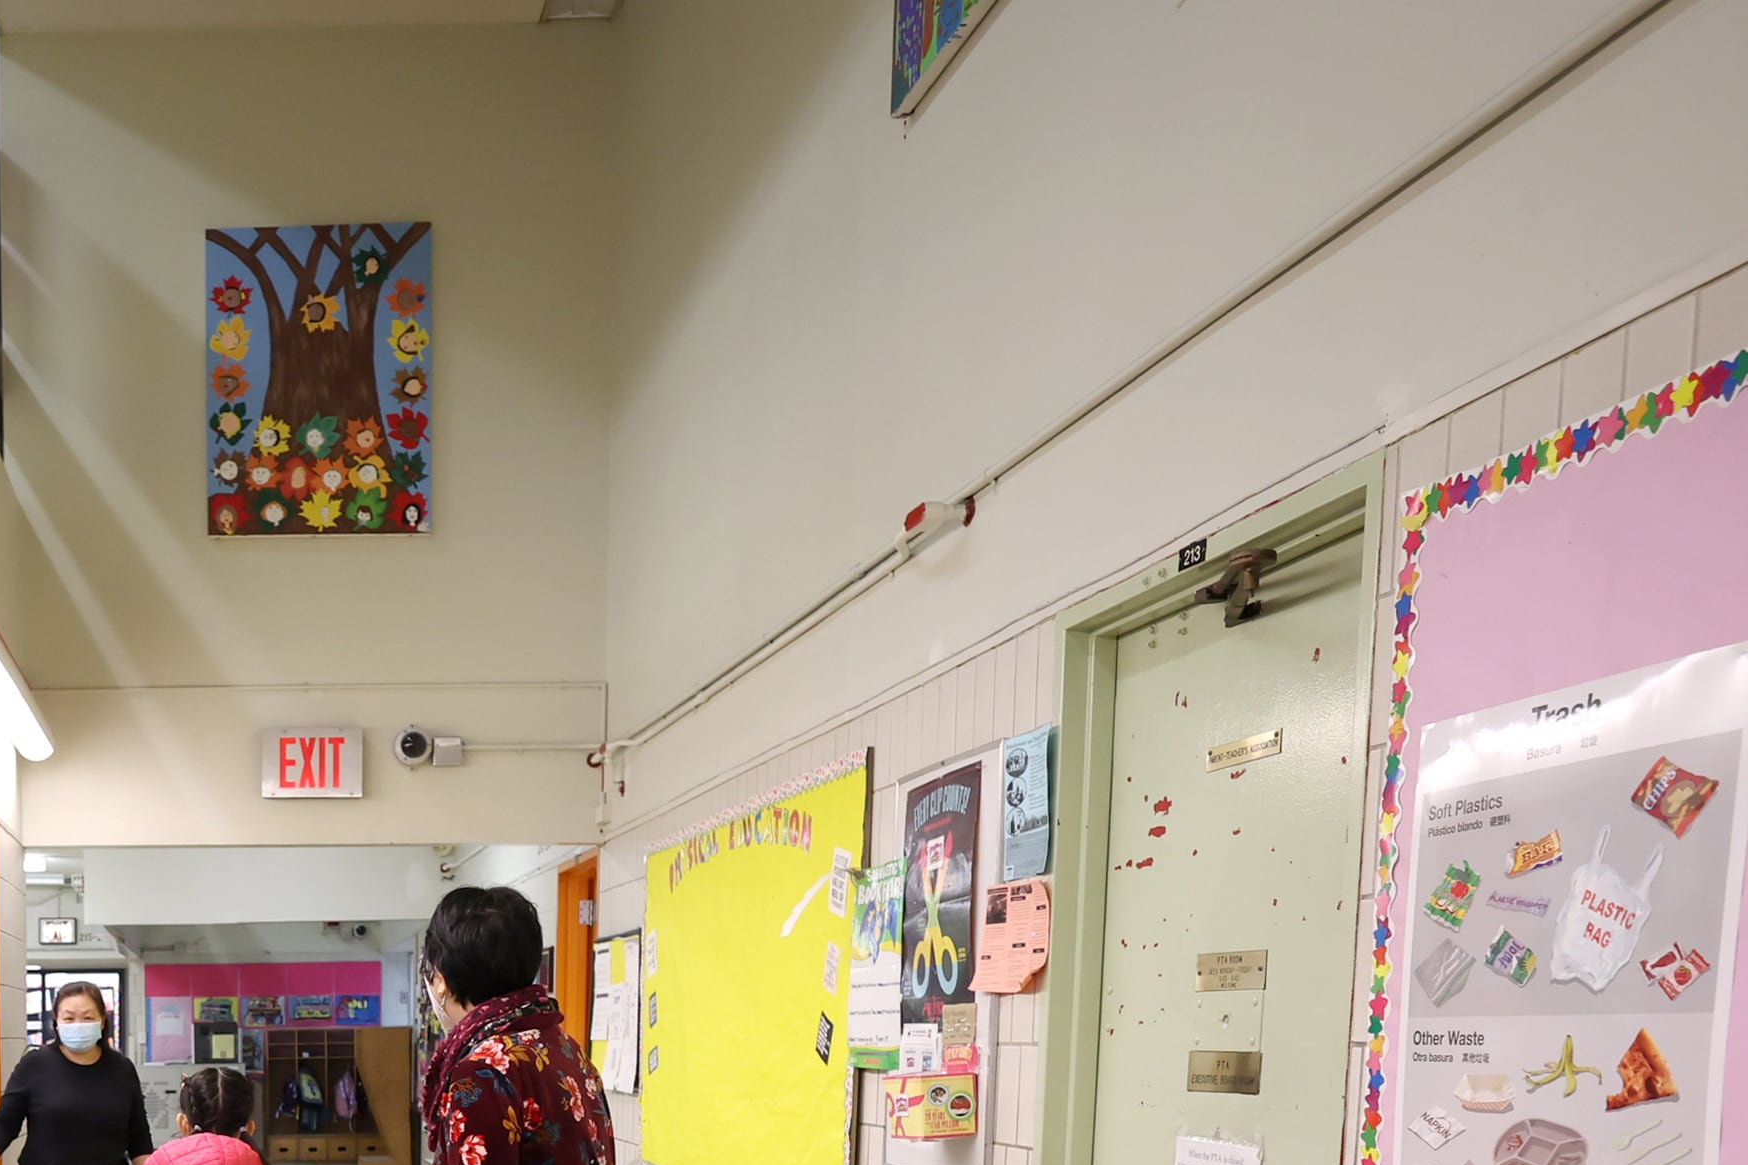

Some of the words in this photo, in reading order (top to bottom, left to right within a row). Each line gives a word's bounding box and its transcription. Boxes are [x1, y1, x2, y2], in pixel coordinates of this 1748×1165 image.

[1183, 545, 1201, 566] 213
[279, 737, 345, 788] EXIT
[1643, 768, 1677, 810] CHIPS
[1429, 803, 1452, 821] Soft
[1455, 795, 1503, 816] Plastics
[729, 808, 812, 854] EDUCATION
[1457, 819, 1483, 833] blando
[1522, 842, 1553, 863] BAR
[1581, 889, 1636, 930] PLASTIC
[1583, 921, 1612, 949] BAG
[1413, 1030, 1445, 1046] Other
[1448, 1030, 1485, 1046] Waste
[1216, 1060, 1229, 1070] PTA
[1412, 1052, 1428, 1062] Otra
[1429, 1052, 1453, 1063] basura
[1420, 1111, 1452, 1140] NAPKIN
[1211, 1153, 1222, 1163] PTA
